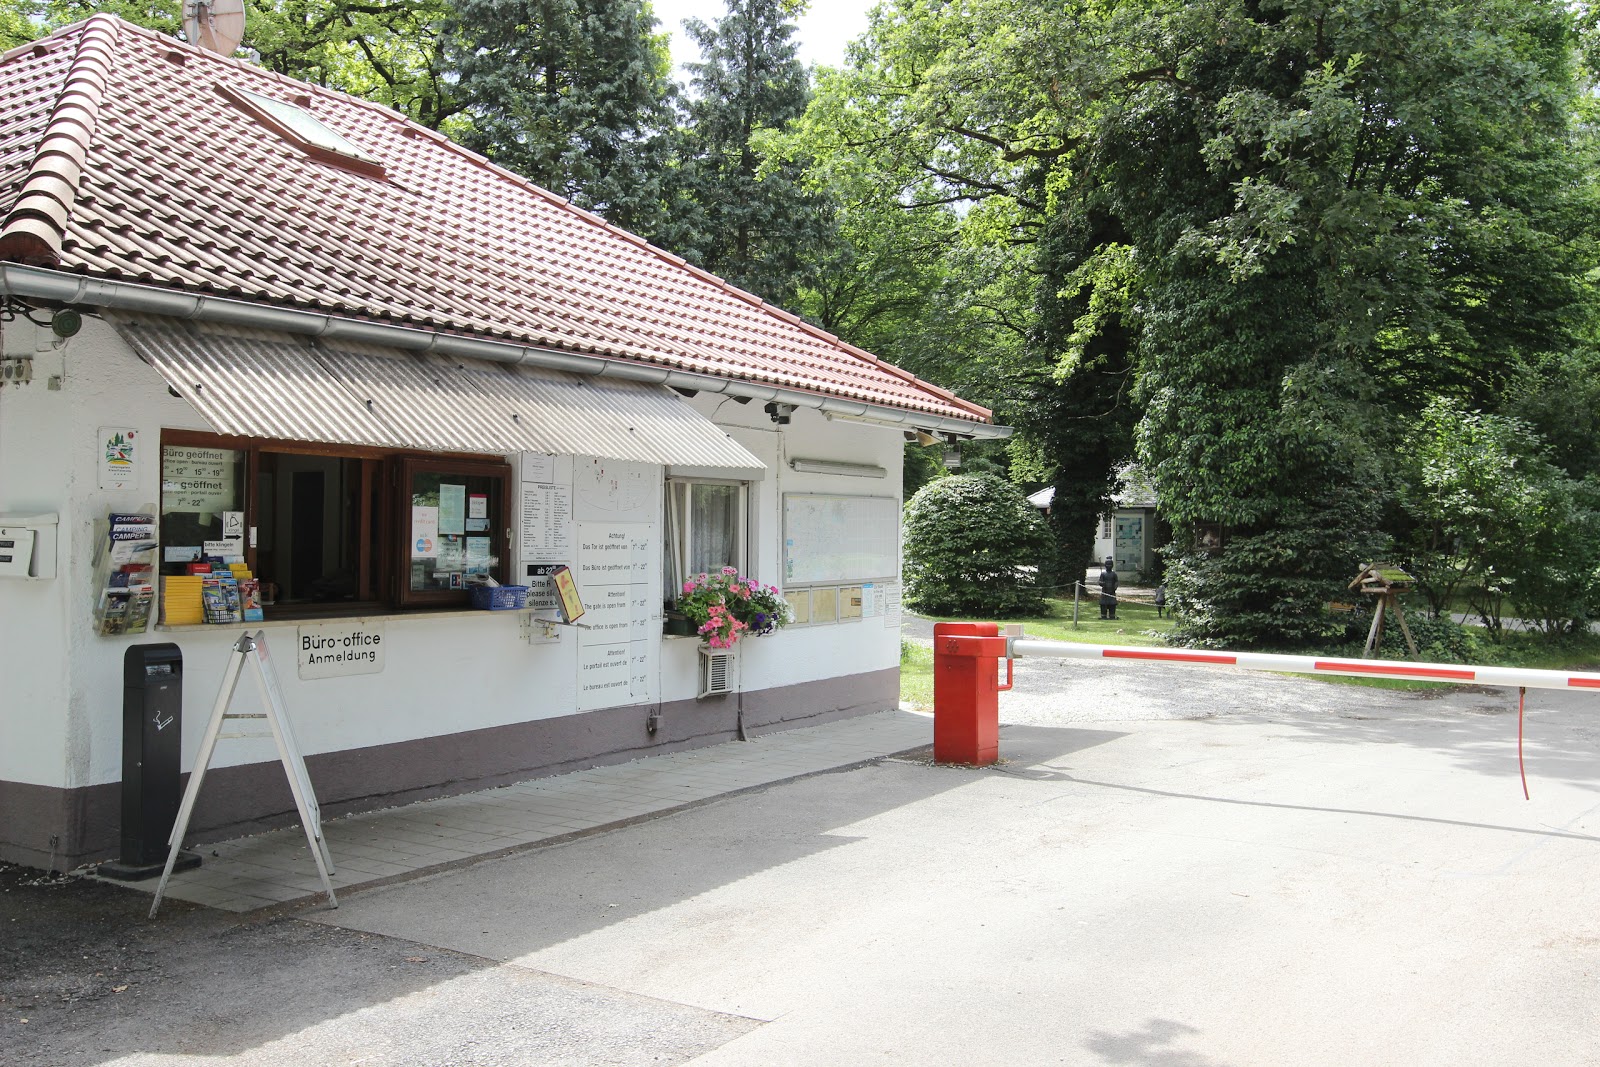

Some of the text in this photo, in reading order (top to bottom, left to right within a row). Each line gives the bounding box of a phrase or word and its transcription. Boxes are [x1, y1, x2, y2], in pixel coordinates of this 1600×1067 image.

[164, 449, 222, 459] Büro geöffnet
[181, 481, 222, 489] geöffnet
[302, 632, 380, 650] Büro-office
[309, 650, 375, 664] Anmeldung
